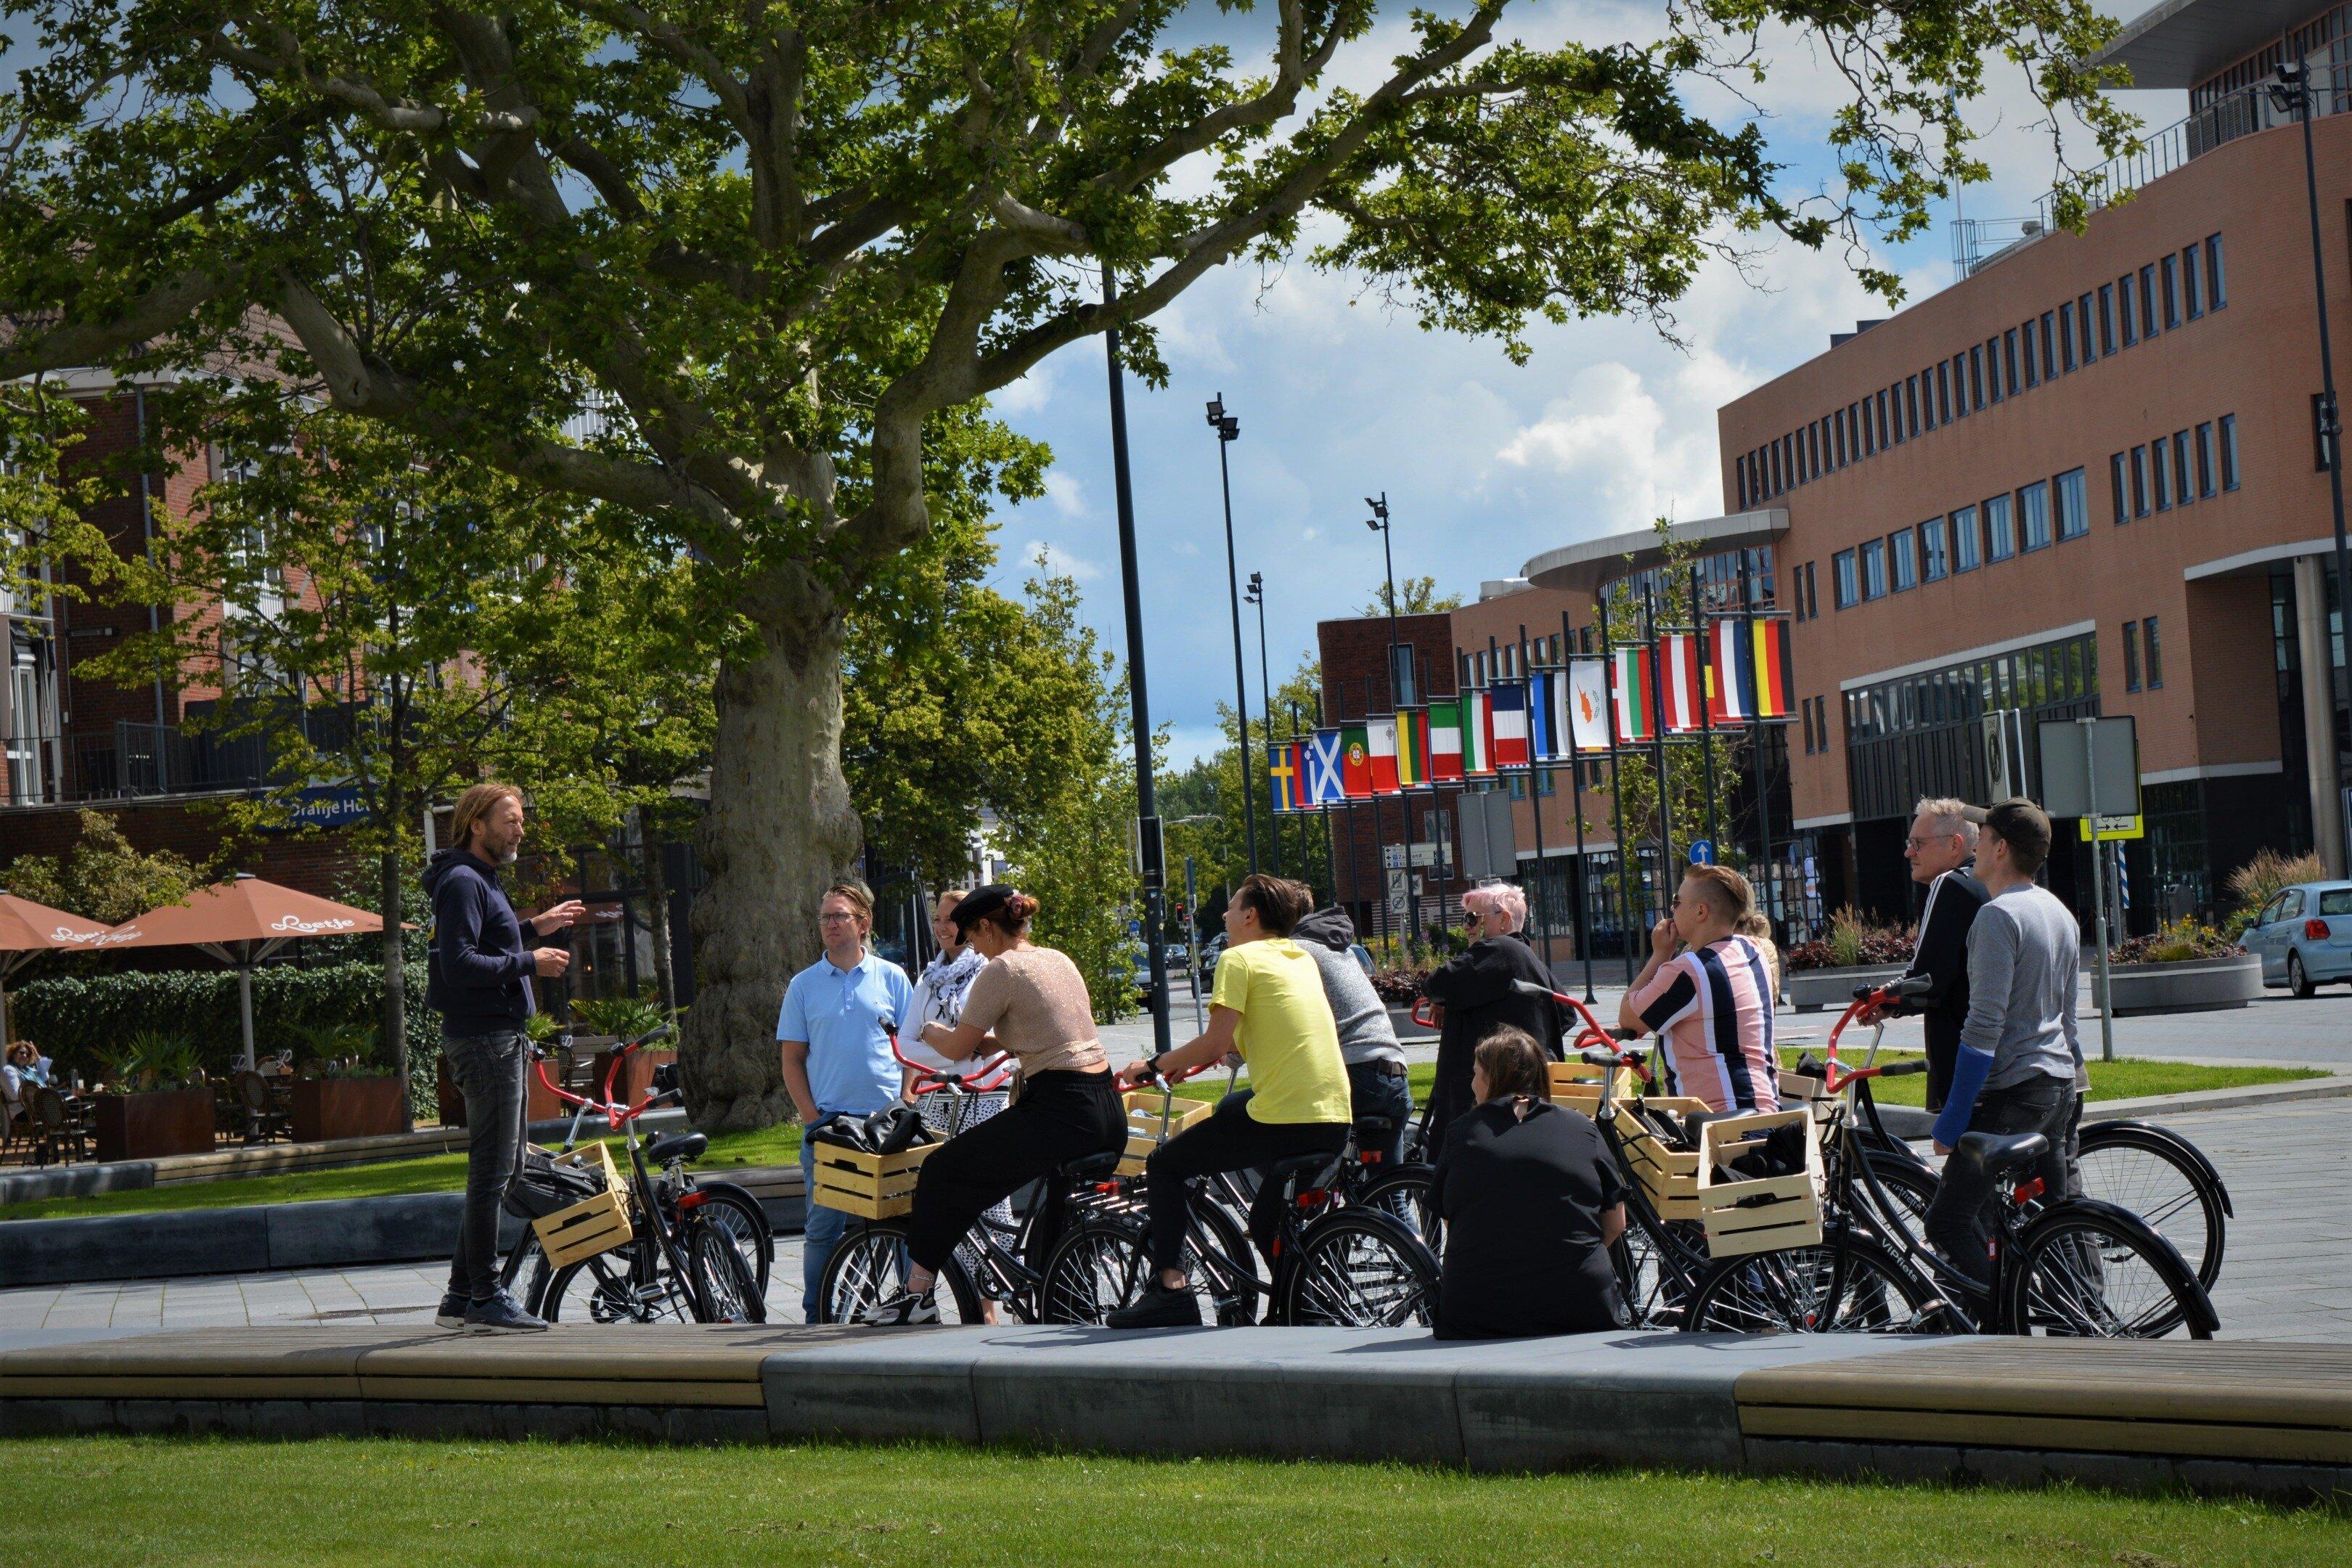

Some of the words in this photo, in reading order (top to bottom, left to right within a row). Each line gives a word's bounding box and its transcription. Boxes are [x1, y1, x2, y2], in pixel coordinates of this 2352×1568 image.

[271, 915, 355, 933] Loetje
[967, 1242, 994, 1281] VIPfiets
[1882, 1238, 1917, 1283] VIPfiets
